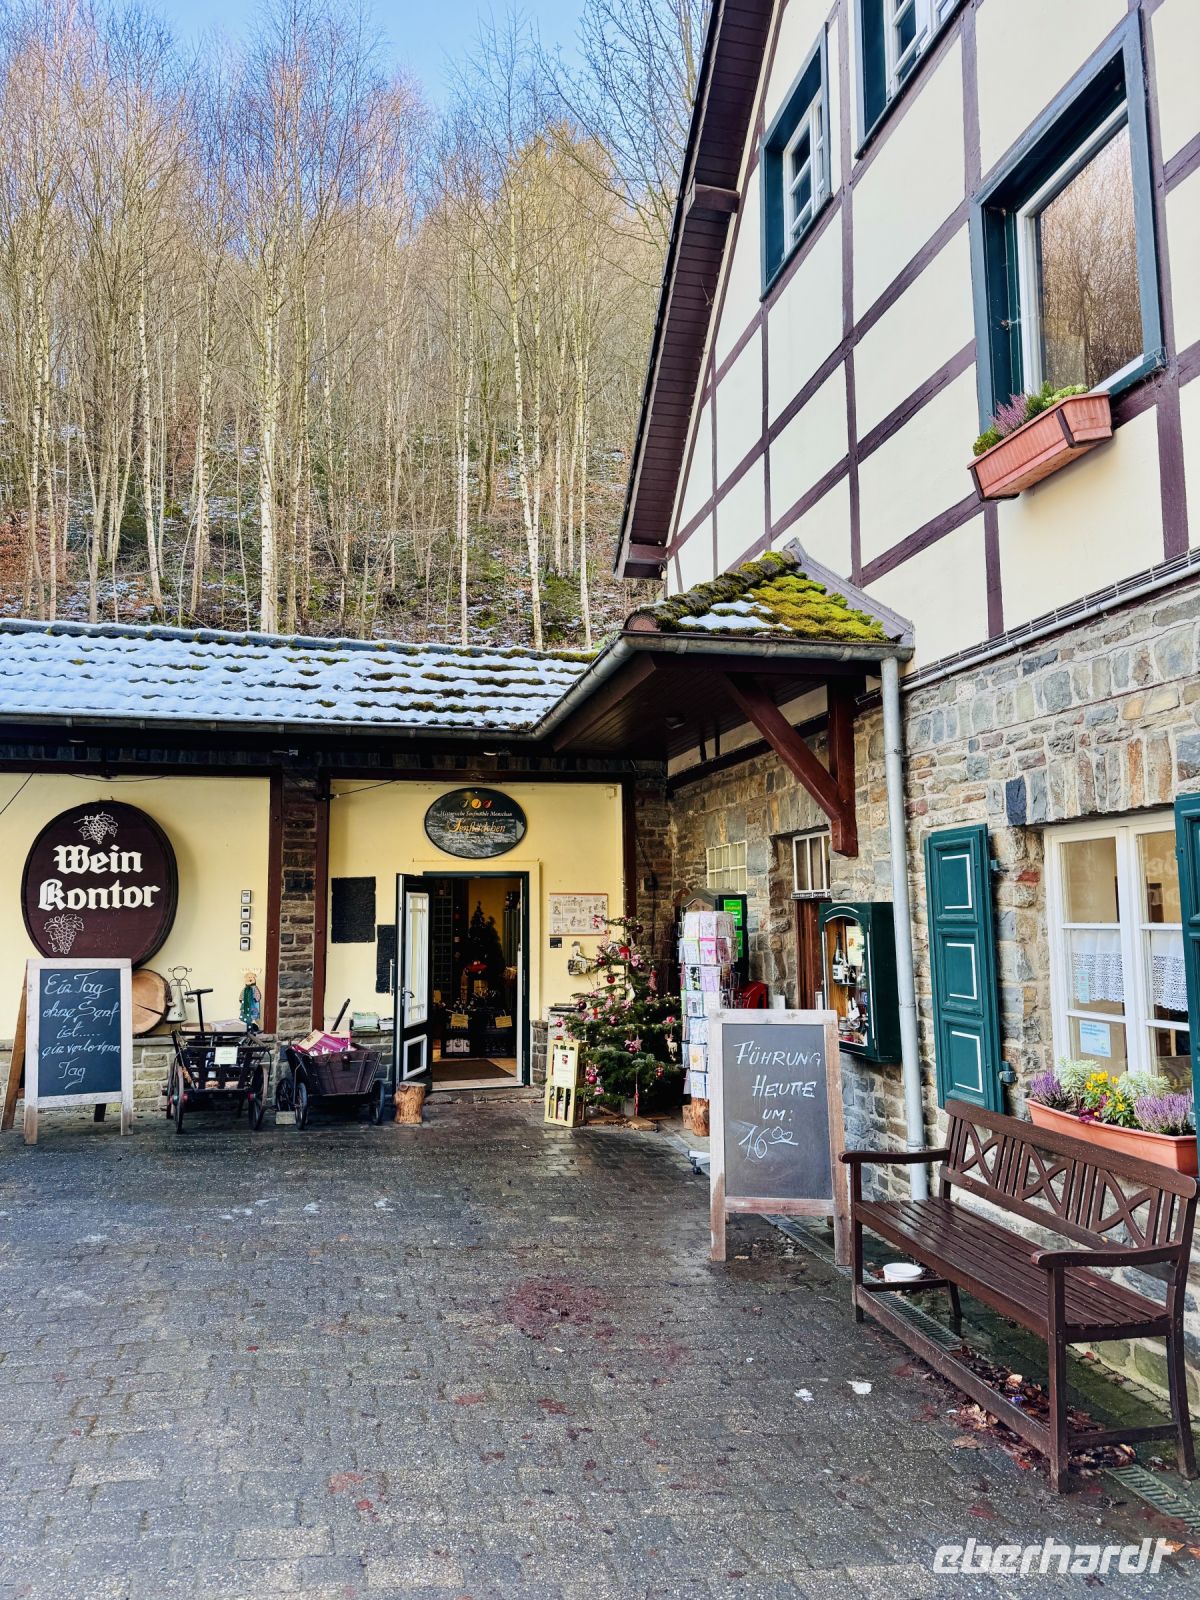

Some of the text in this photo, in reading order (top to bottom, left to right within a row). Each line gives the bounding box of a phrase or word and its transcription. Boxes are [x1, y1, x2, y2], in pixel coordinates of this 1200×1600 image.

[53, 844, 144, 874] Wein
[38, 878, 161, 911] Kontor
[44, 970, 114, 999] Ein Tag
[43, 1000, 120, 1026] ohne Senf
[41, 1042, 64, 1060] ein
[733, 1040, 821, 1067] FÜHRUNG
[58, 1057, 86, 1090] Tag
[751, 1074, 817, 1098] HEUTE
